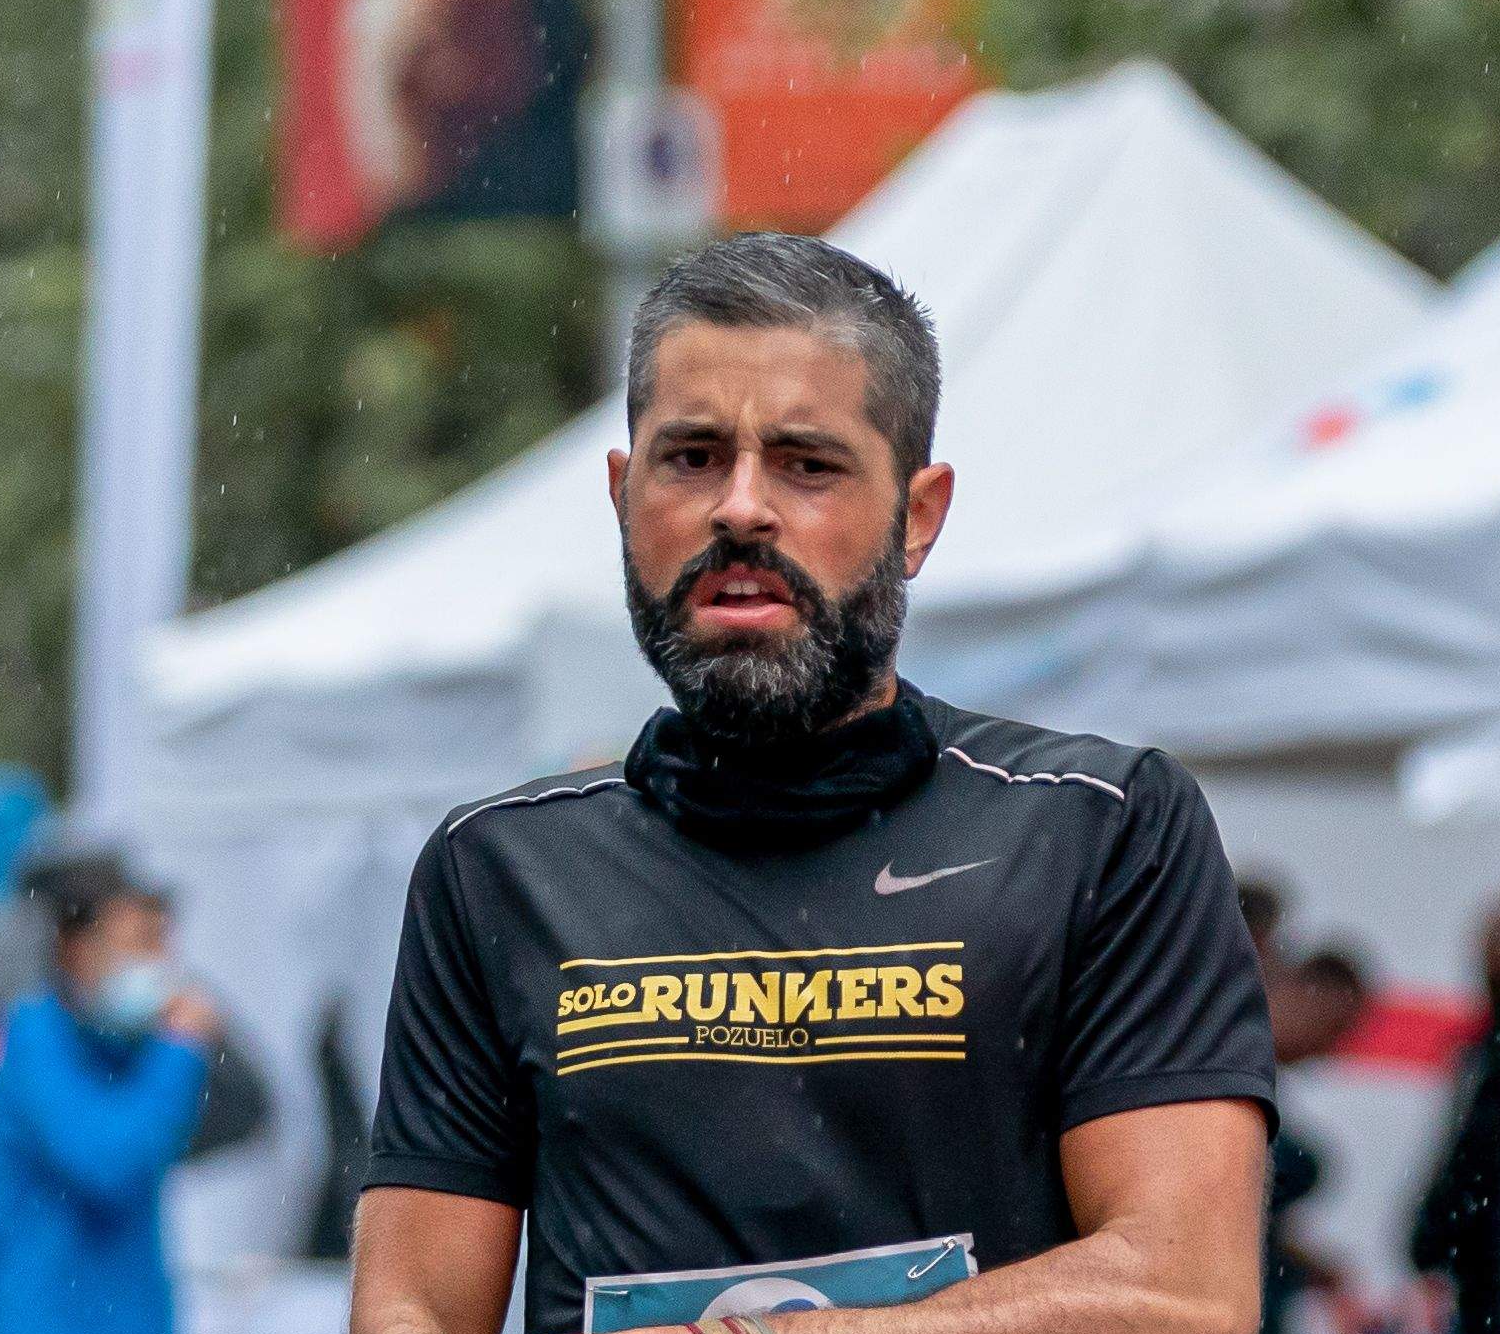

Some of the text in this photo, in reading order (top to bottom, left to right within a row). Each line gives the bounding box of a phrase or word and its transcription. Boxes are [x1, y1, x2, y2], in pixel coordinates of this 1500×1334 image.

[557, 963, 966, 1024] SOLO RUNNERS
[695, 1024, 810, 1049] POZUELO
